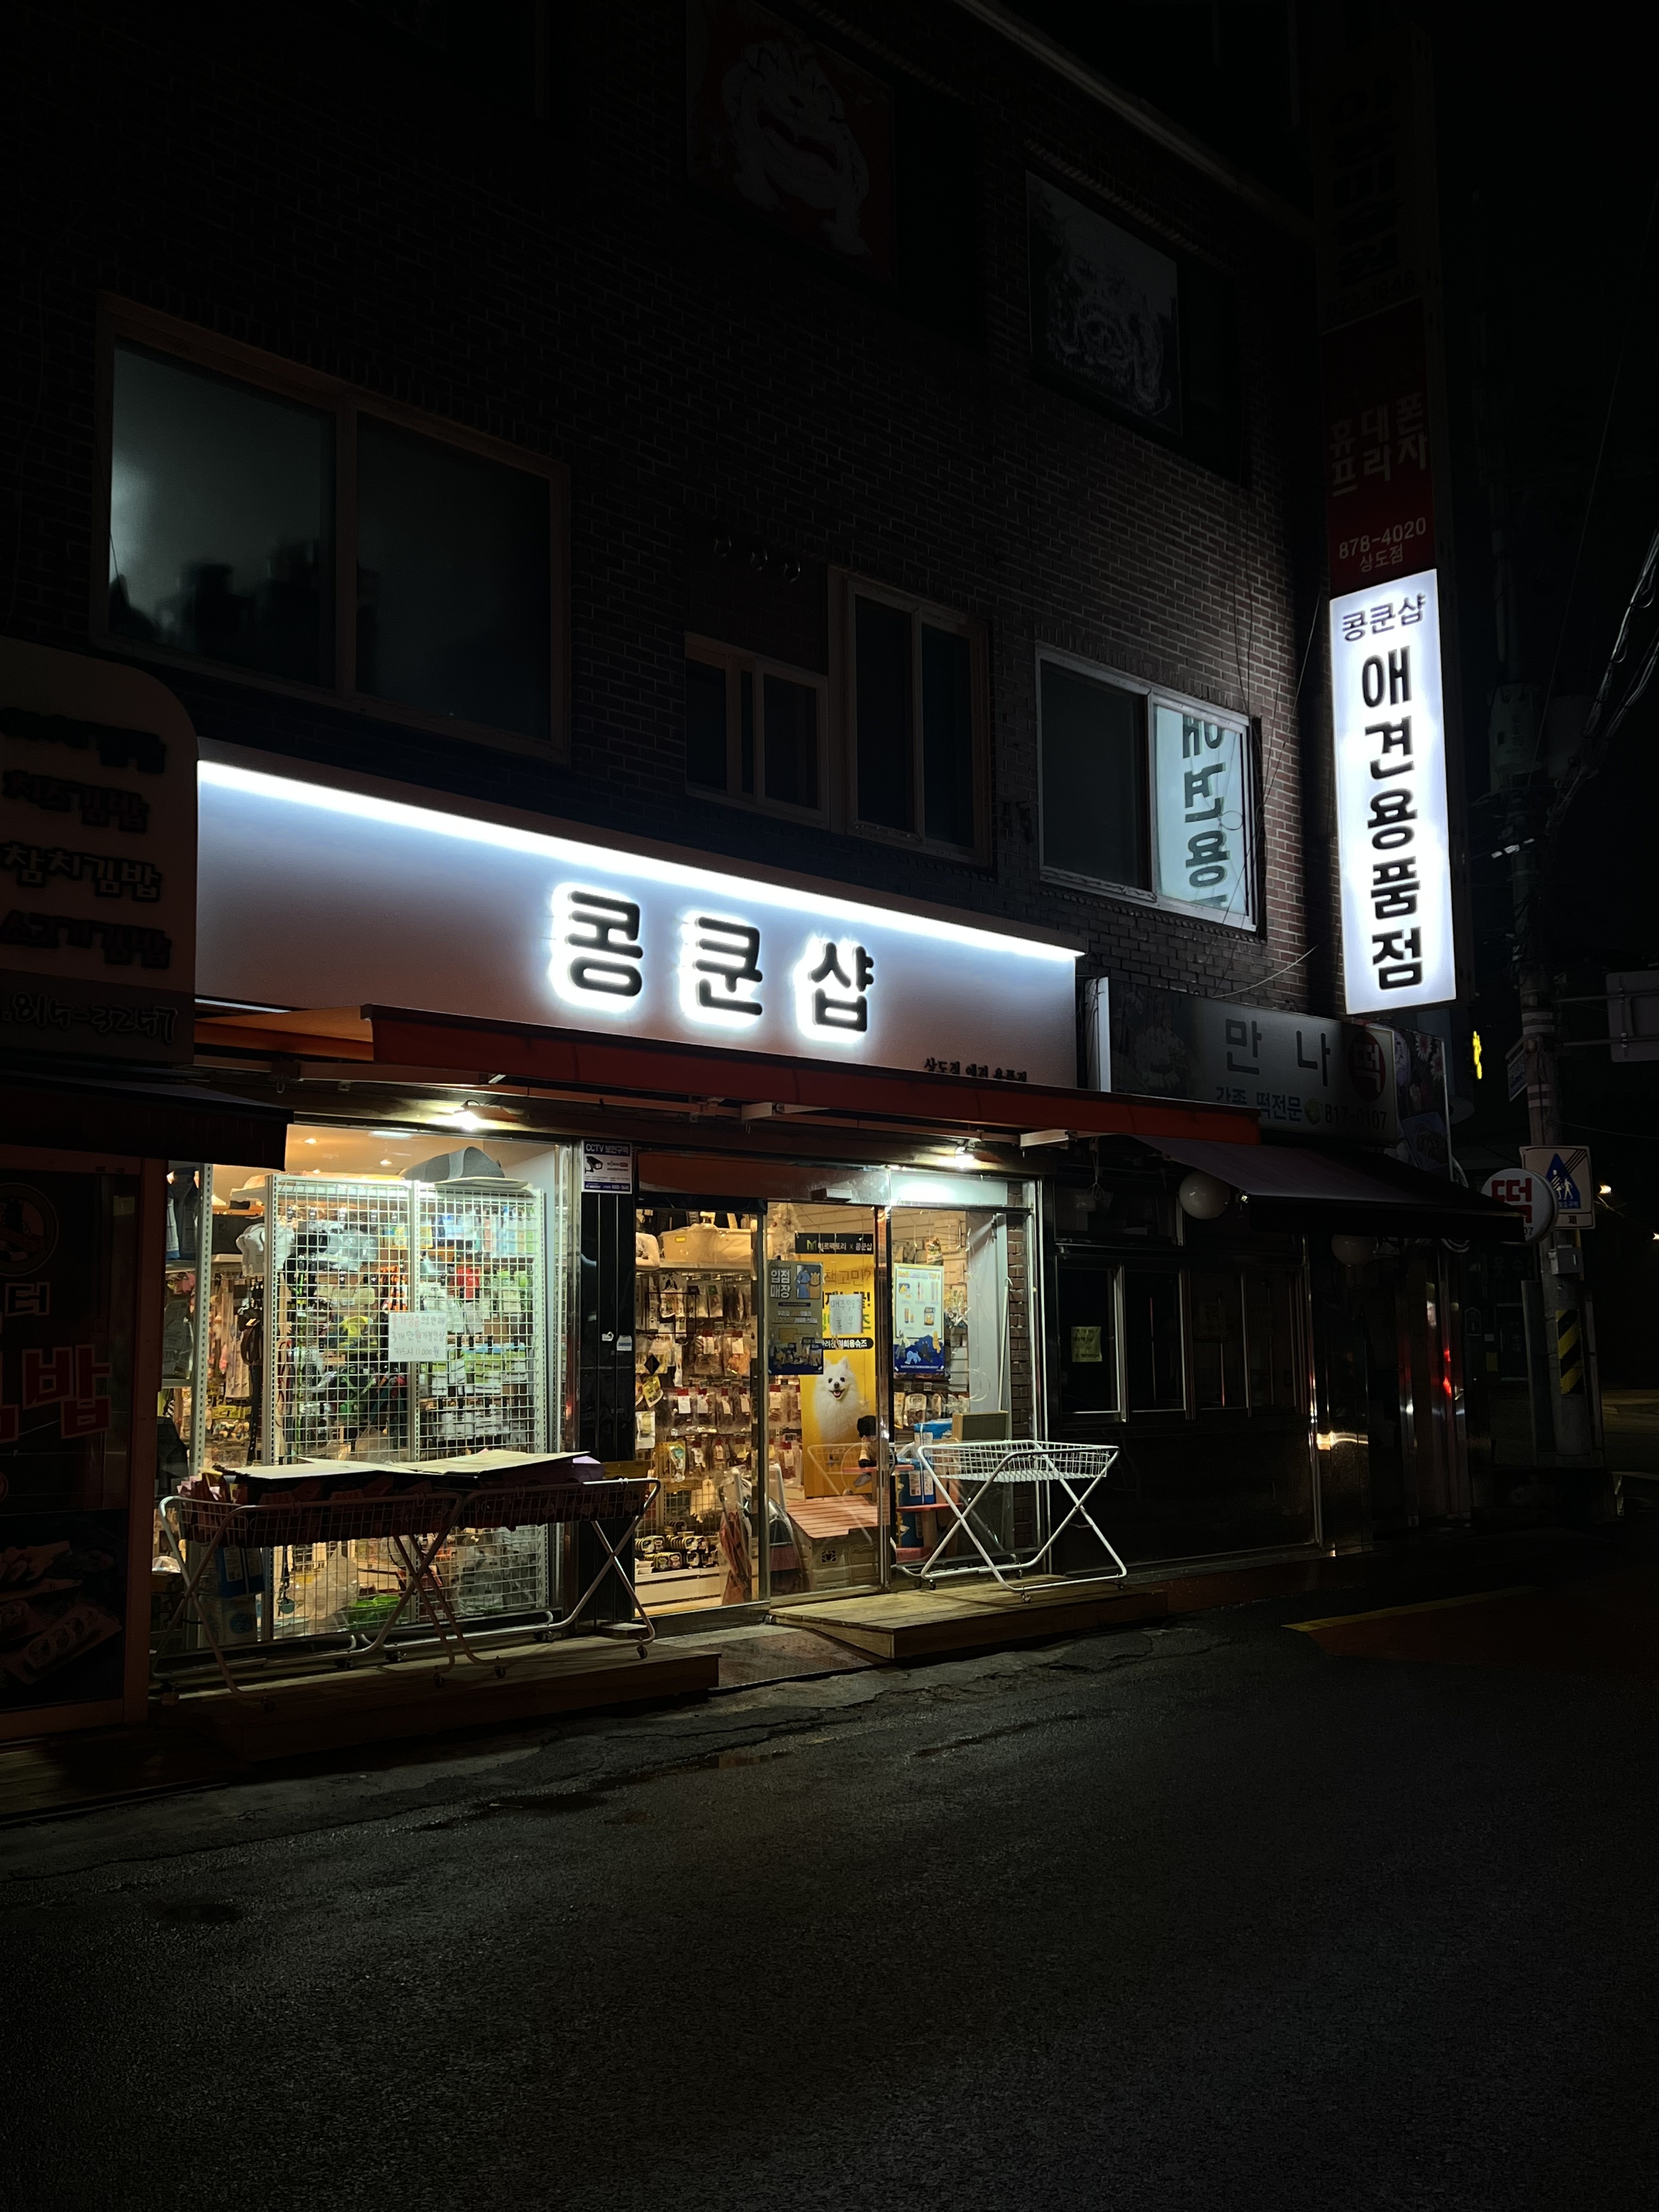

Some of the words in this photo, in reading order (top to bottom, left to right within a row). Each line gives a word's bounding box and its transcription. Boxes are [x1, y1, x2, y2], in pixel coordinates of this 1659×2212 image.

[1329, 391, 1425, 458] 휴대폰
[1332, 432, 1430, 498] 프라자
[1339, 517, 1426, 560] 878-4020
[1359, 543, 1403, 573] 상도점
[1342, 592, 1426, 642] 콩쿤샵
[1361, 645, 1424, 991] 애견용품점
[0, 841, 162, 902] 참치김밥
[566, 890, 874, 1032] 콩쿤샵
[1324, 1103, 1387, 1130] 817-0107
[585, 1143, 603, 1153] CCTV
[770, 1284, 791, 1299] 매장
[771, 1269, 791, 1284] 입점
